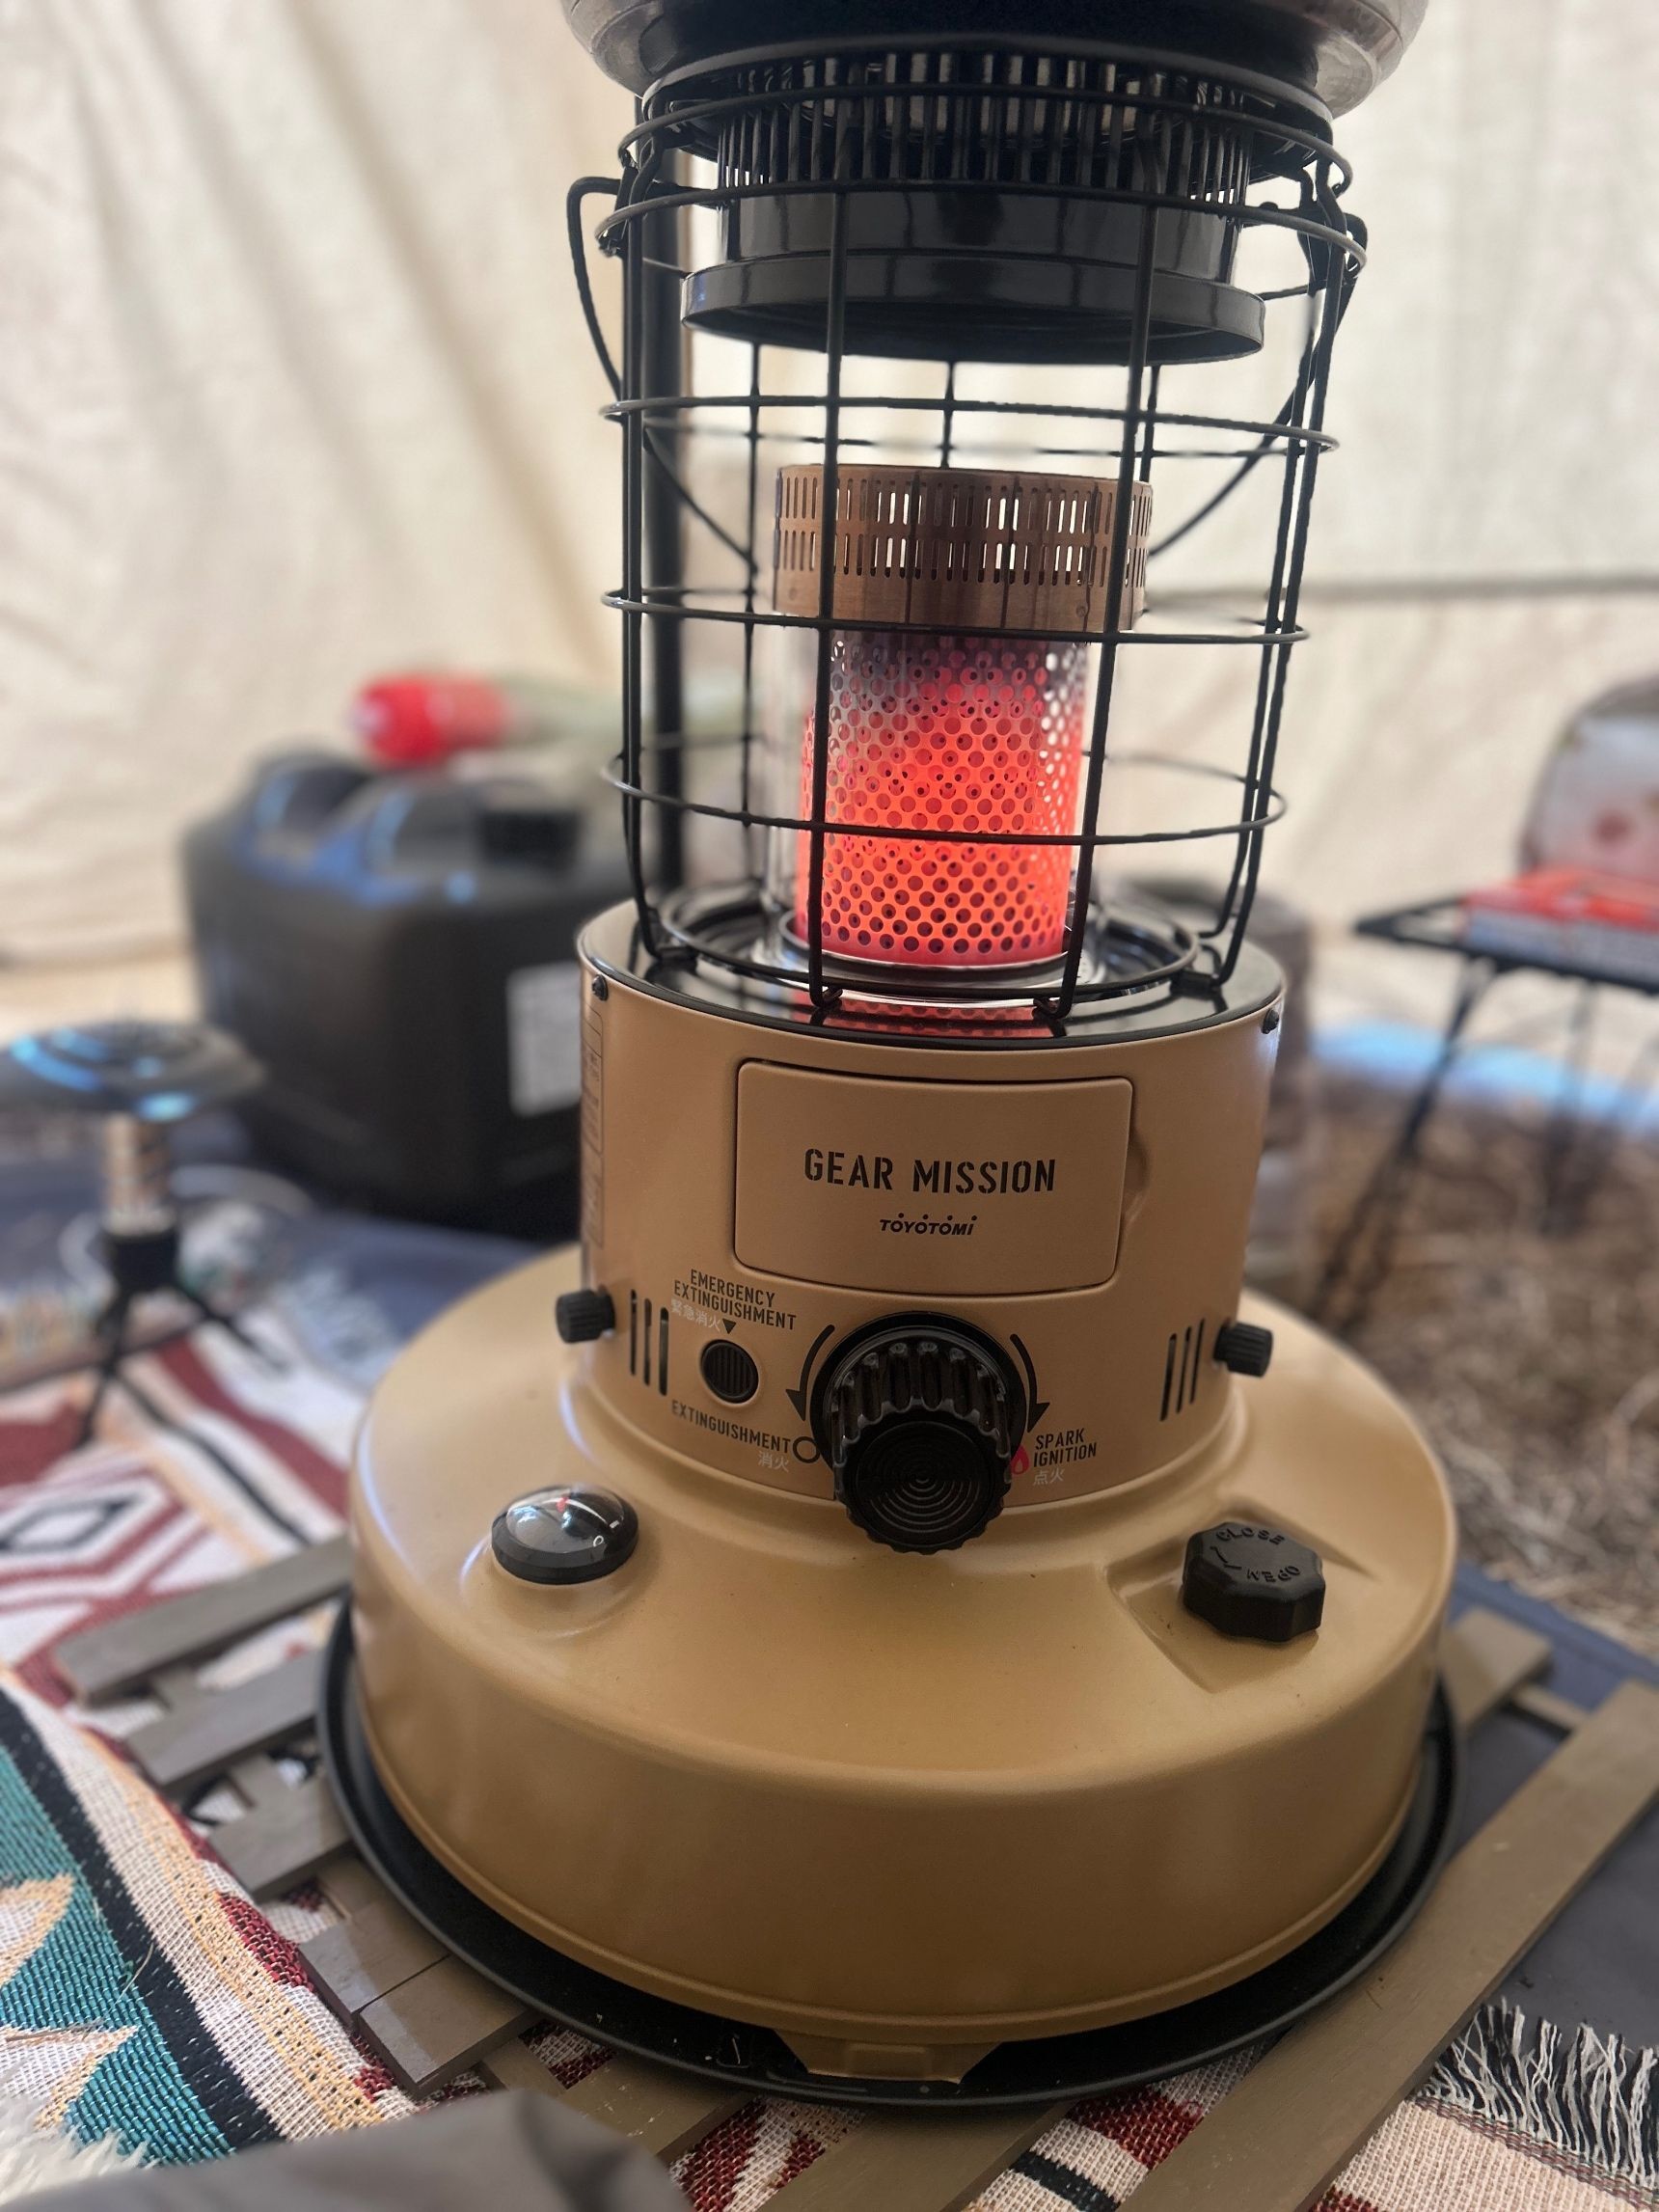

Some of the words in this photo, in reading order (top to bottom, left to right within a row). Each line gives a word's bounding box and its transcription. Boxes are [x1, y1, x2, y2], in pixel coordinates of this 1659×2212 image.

[804, 1148, 893, 1190] GEAR
[912, 1159, 1056, 1194] MISSION
[879, 1213, 978, 1236] TOYOTOMI
[690, 1268, 775, 1308] EMERGENCY
[674, 1279, 797, 1330] EXTINGUISHMENT
[671, 1399, 791, 1454] EXTINGUISHMENT
[1035, 1427, 1085, 1451] SPARK
[757, 1450, 790, 1473] 消火
[1033, 1442, 1098, 1468] IGNITION
[1032, 1466, 1065, 1487] 点火
[1215, 1526, 1286, 1545] CLOSE
[1245, 1564, 1301, 1584] OPEN
